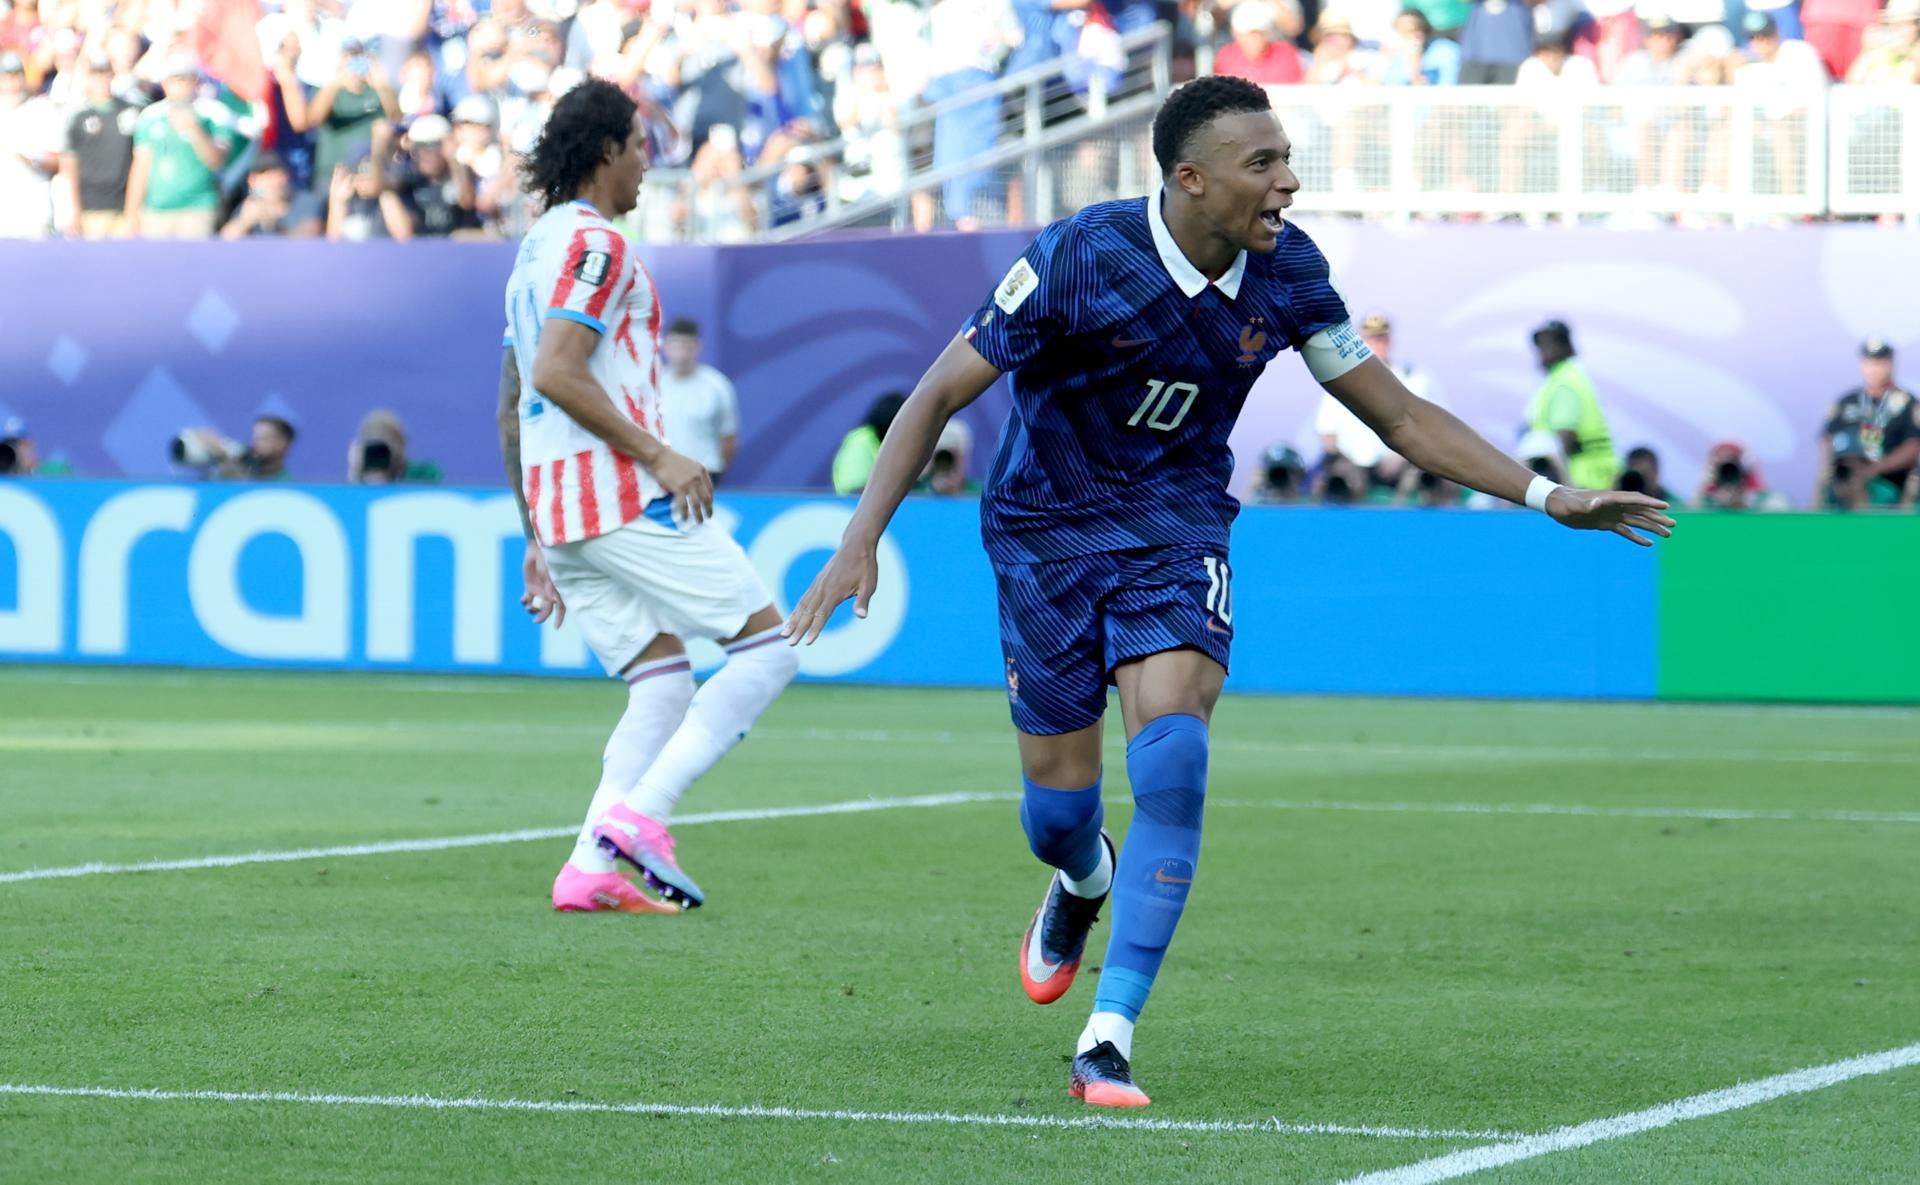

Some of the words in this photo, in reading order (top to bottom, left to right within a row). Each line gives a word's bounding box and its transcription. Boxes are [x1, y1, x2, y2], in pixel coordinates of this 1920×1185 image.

[1127, 378, 1199, 431] 10
[0, 484, 909, 677] ramo
[1203, 556, 1233, 626] 10
